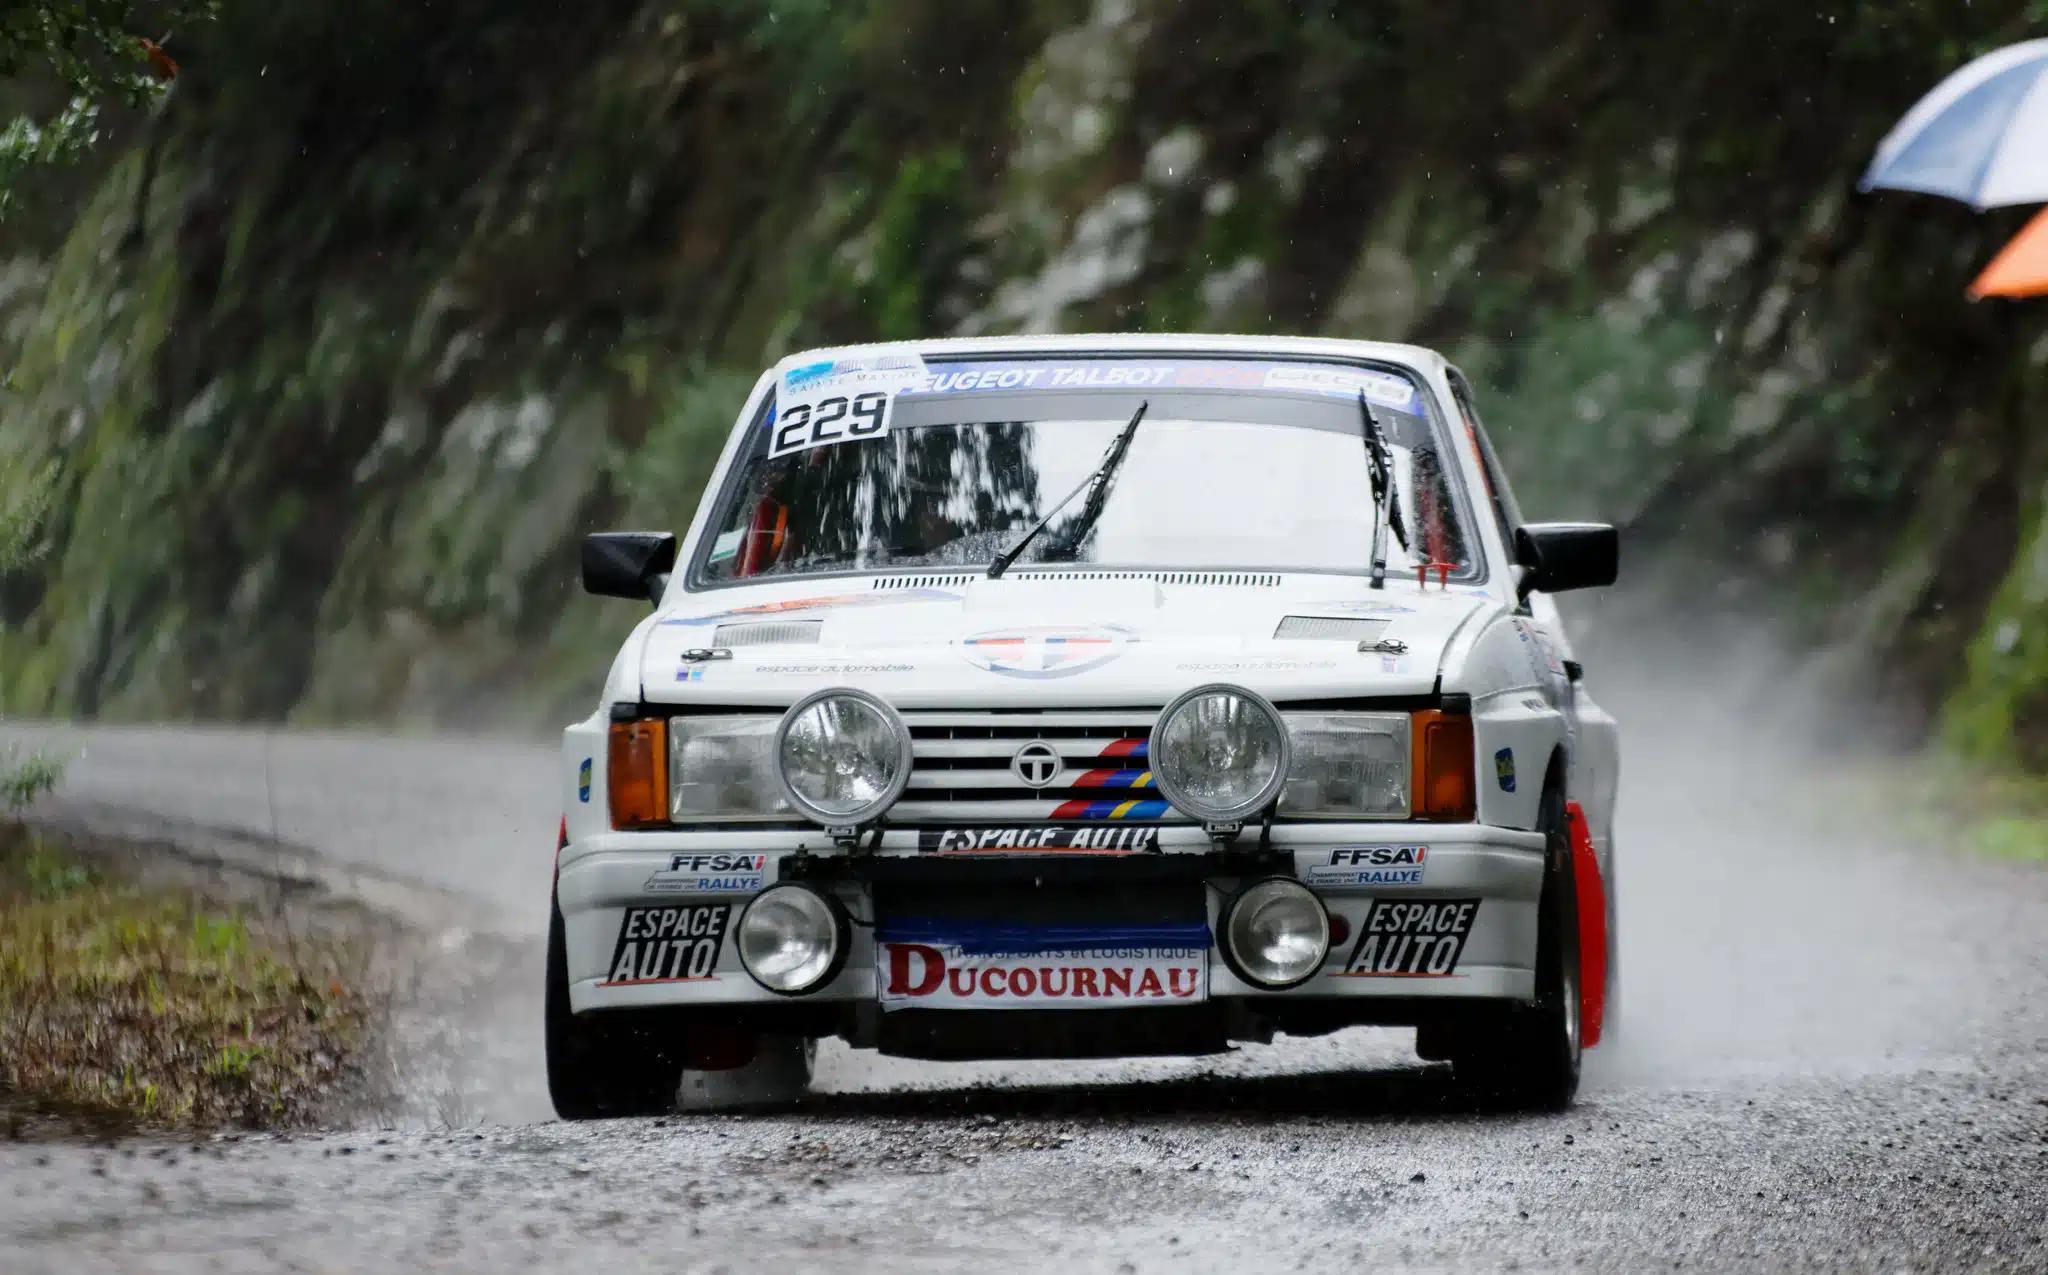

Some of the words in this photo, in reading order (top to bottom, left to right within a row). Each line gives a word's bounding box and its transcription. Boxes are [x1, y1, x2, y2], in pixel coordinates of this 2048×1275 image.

[912, 367, 1043, 392] EUGEOT
[1050, 367, 1174, 386] TALBOT
[775, 391, 888, 451] 229
[756, 664, 819, 676] espace
[938, 826, 1064, 852] ESPACE
[670, 855, 755, 872] FFSA
[1329, 848, 1416, 865] FFSA
[698, 877, 760, 890] RALLYE
[1357, 871, 1422, 884] RALLYE
[625, 907, 727, 939] ESPACE
[1369, 903, 1475, 933] ESPACE
[612, 938, 717, 981] AUTO
[1092, 948, 1198, 960] LOGISTIQUE
[1350, 934, 1460, 975] AUTO
[885, 943, 1199, 998] DUCOURNAU
